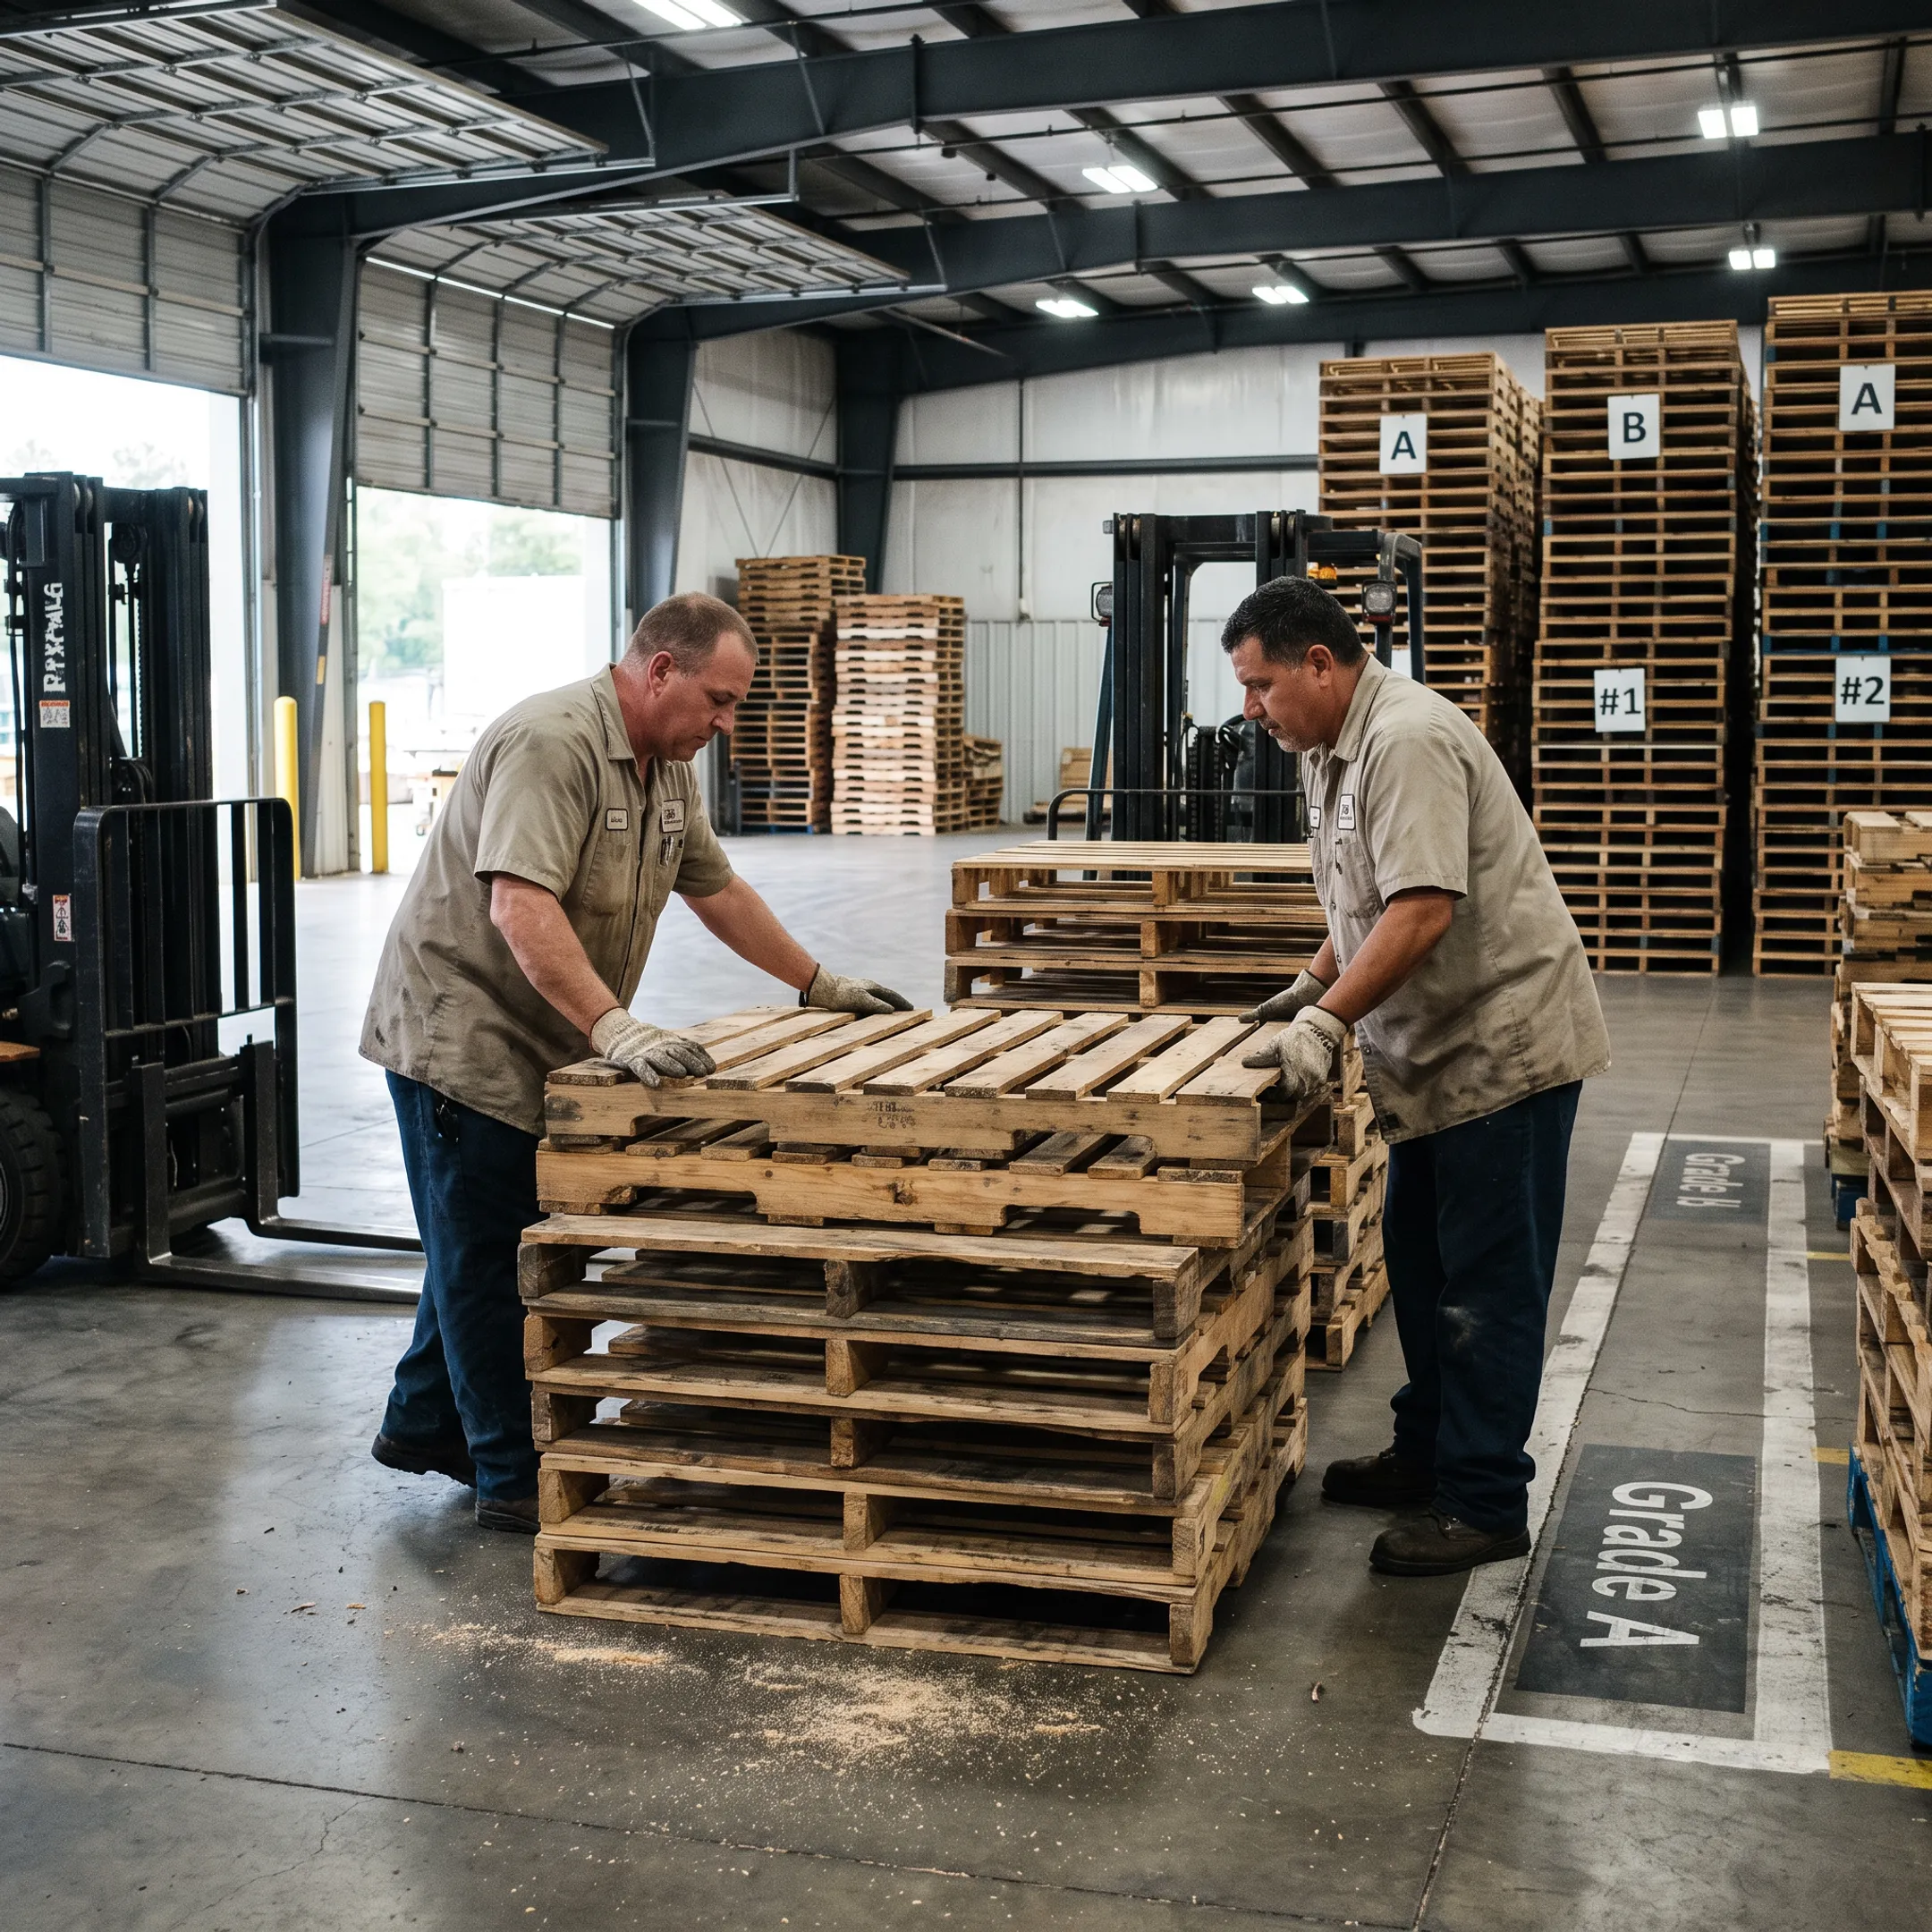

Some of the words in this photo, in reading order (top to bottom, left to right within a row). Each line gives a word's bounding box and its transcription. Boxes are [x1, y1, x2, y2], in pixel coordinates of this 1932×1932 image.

[1851, 382, 1883, 416] A
[1623, 411, 1647, 444] B
[1391, 430, 1417, 461] A
[1599, 687, 1641, 716] #1
[1840, 675, 1885, 706] #2
[1679, 1152, 1746, 1193] Grade
[1591, 1481, 1714, 1601] Grade
[1580, 1610, 1700, 1648] A
